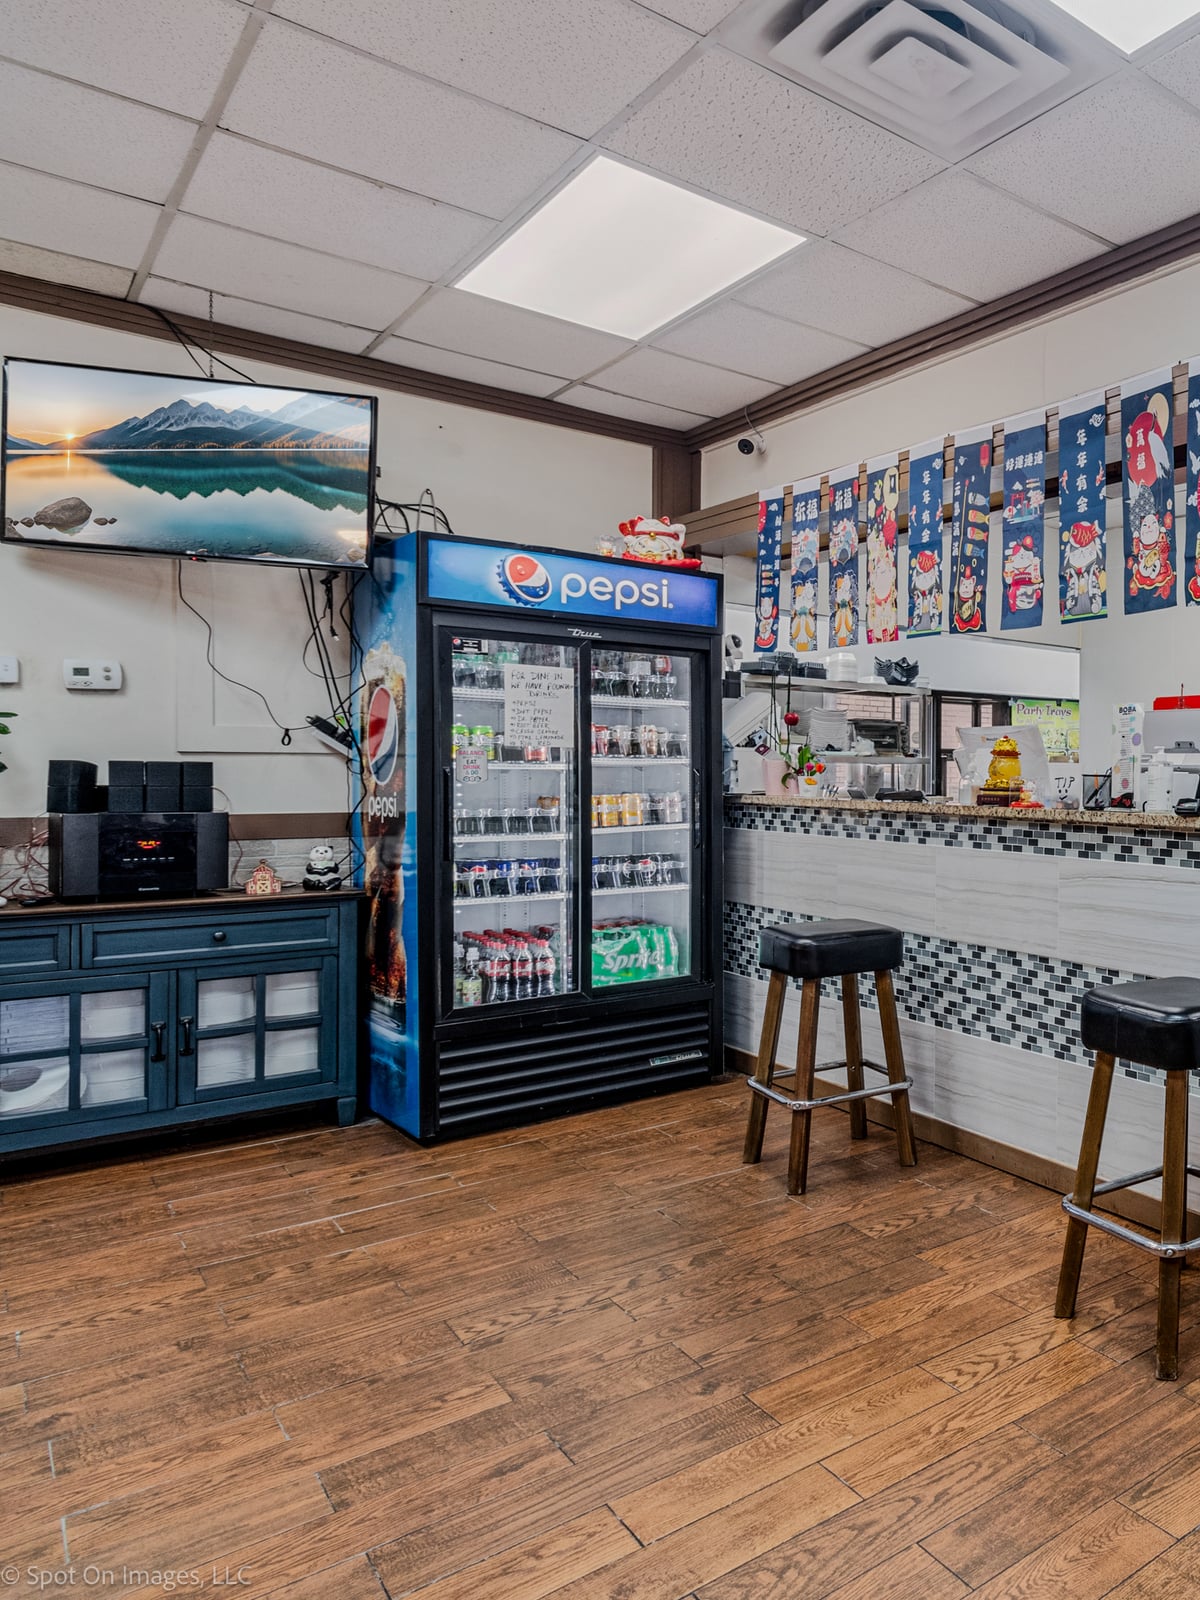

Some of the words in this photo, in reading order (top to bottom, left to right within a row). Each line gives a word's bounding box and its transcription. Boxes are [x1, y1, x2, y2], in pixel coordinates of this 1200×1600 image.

[1016, 703, 1043, 719] Party
[1046, 705, 1072, 719] Trays
[1119, 706, 1136, 714] BOBA
[1055, 776, 1075, 788] TIP
[368, 791, 397, 823] pepsi
[602, 948, 660, 973] Sprite
